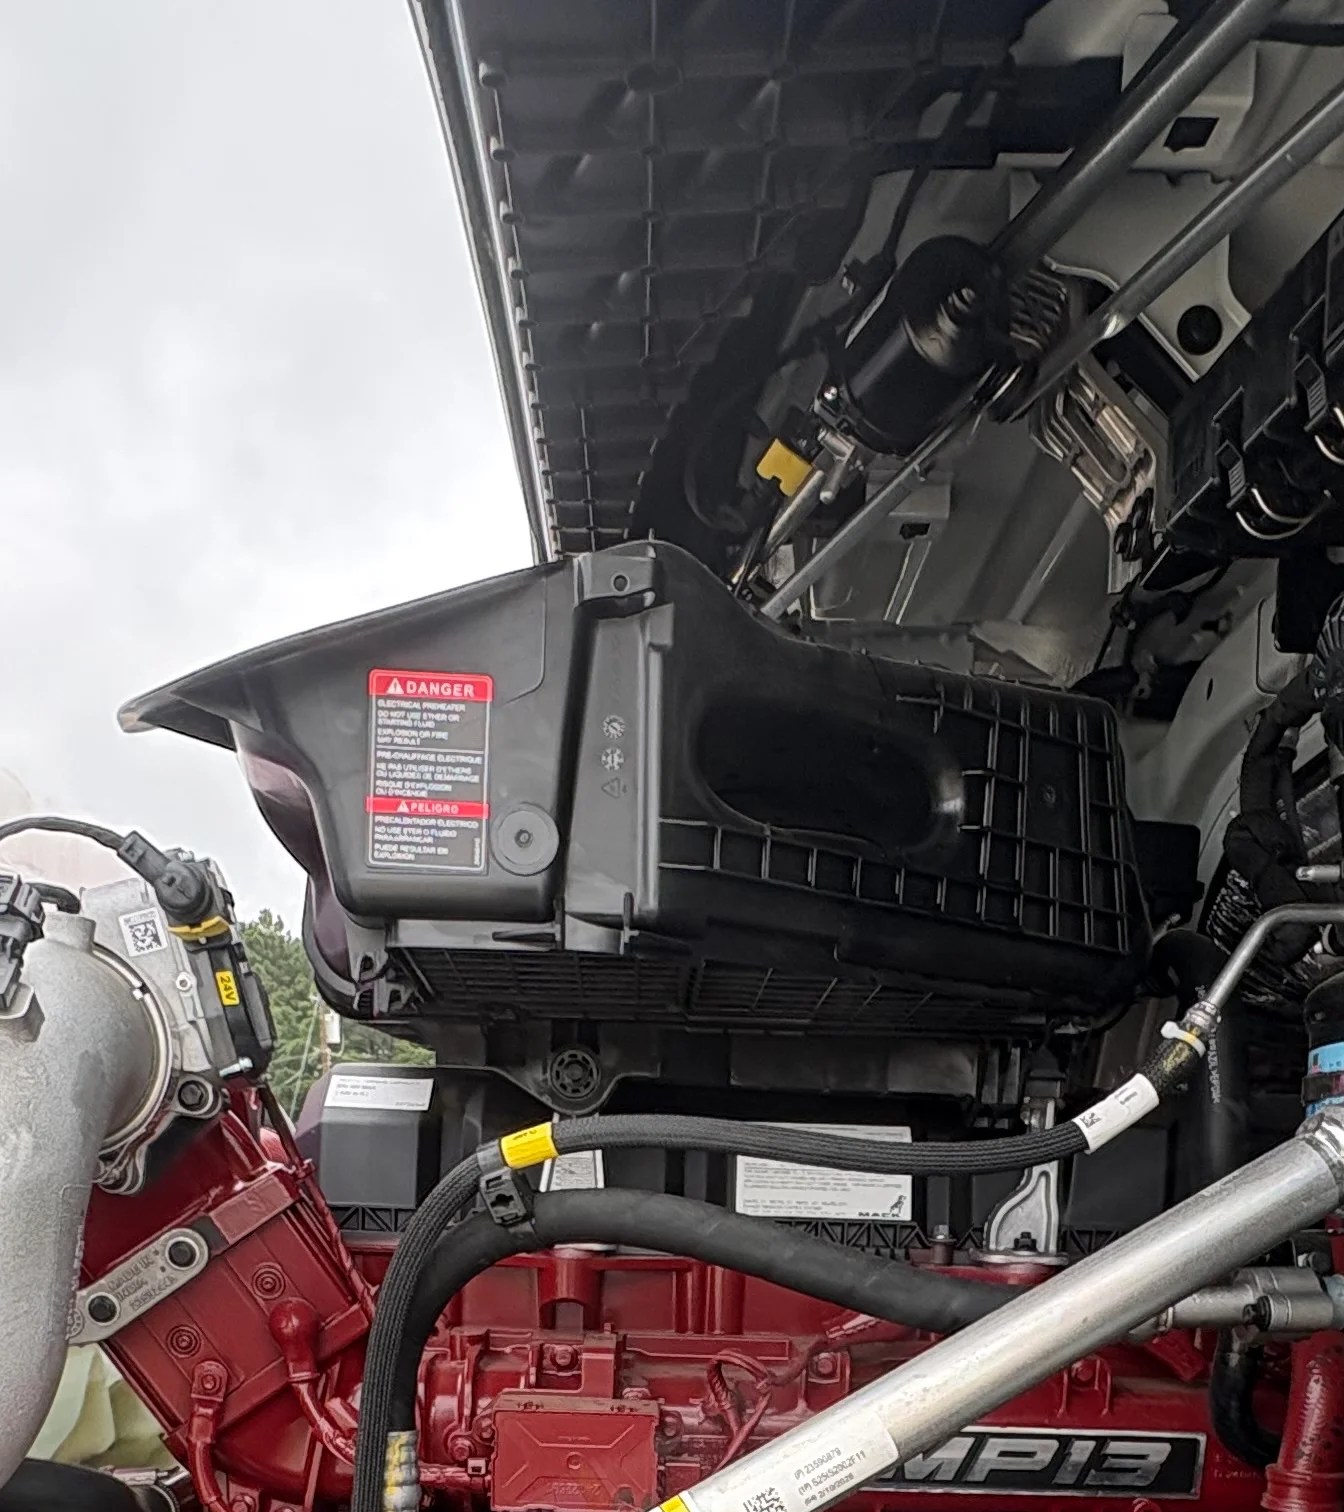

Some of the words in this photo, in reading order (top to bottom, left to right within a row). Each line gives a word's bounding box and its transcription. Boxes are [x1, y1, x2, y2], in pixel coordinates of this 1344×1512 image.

[407, 681, 475, 697] DANGER
[410, 803, 459, 813] PELIGRO
[219, 975, 236, 1001] 24V
[881, 1436, 1173, 1487] MP13
